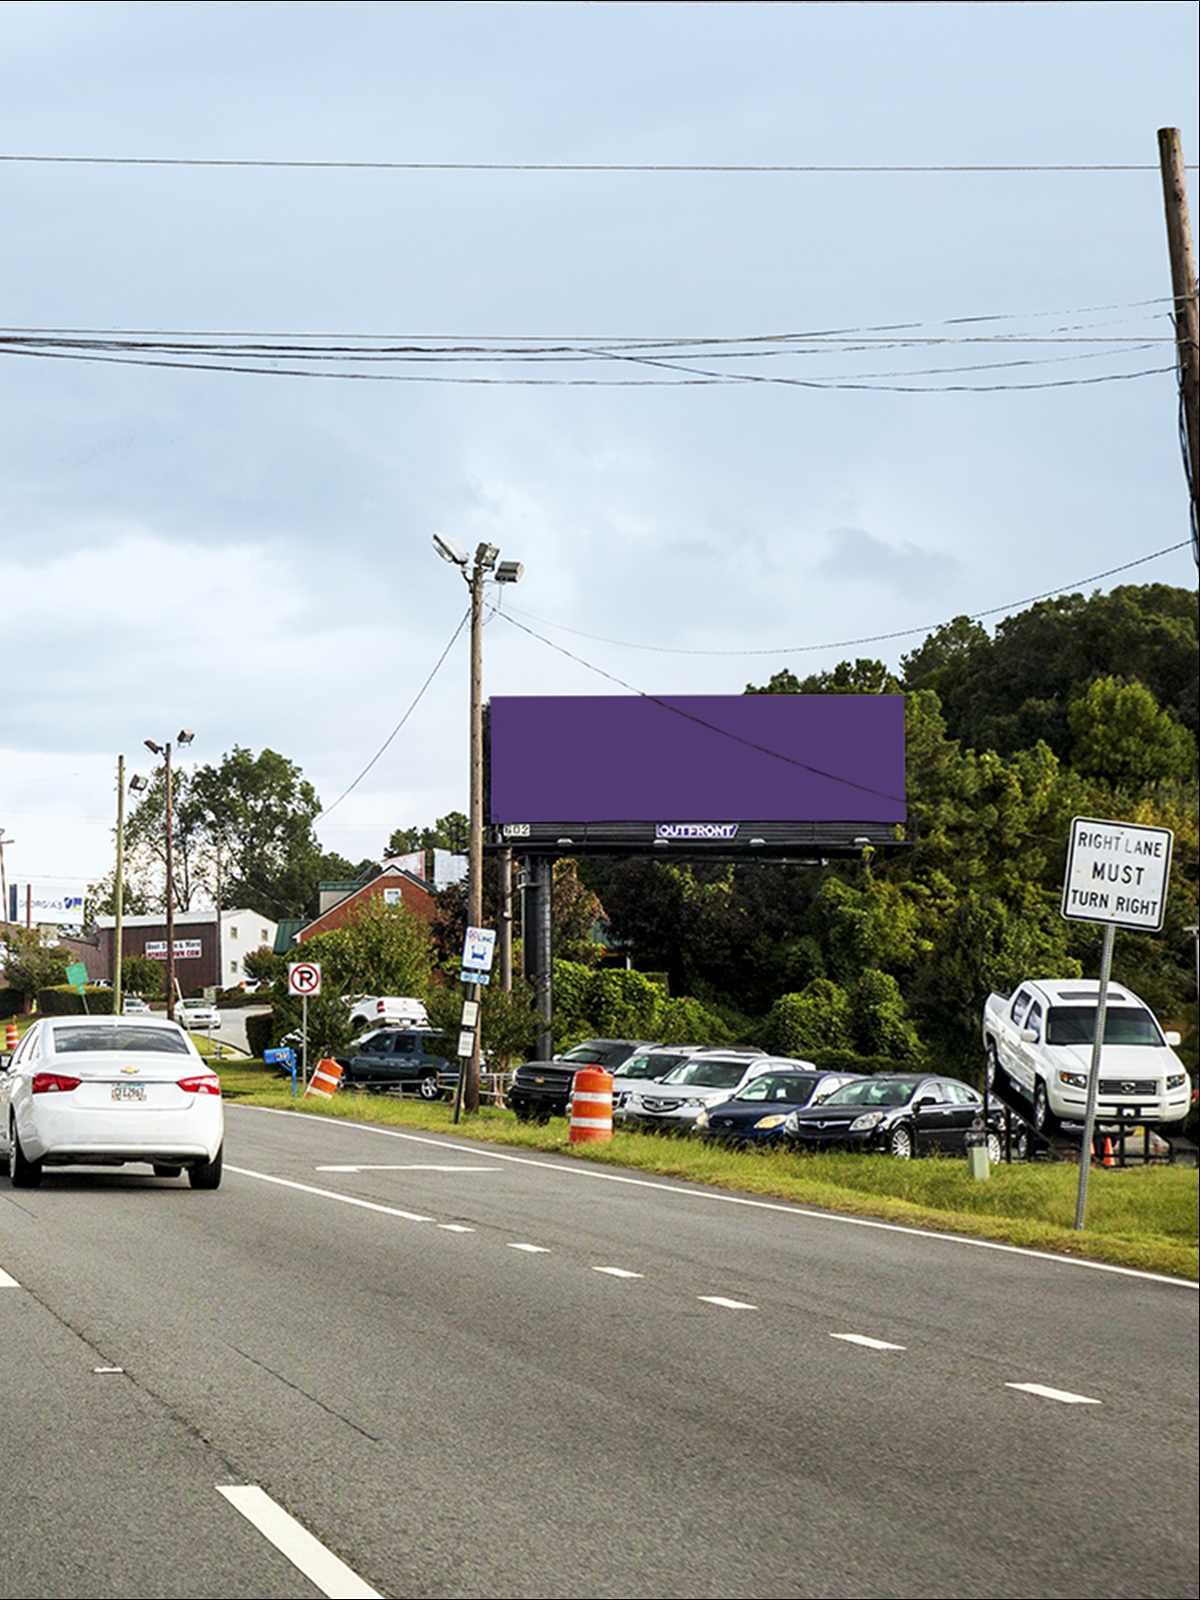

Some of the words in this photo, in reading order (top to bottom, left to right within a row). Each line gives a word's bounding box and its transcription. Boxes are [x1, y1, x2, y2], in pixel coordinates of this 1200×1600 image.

[504, 824, 529, 835] 602
[658, 823, 735, 838] OUTFRONT
[1077, 831, 1121, 852] RIGHT
[1125, 838, 1163, 858] LANE
[1091, 861, 1145, 886] MUST
[1071, 888, 1109, 909] TURN
[1115, 896, 1159, 916] RIGHT
